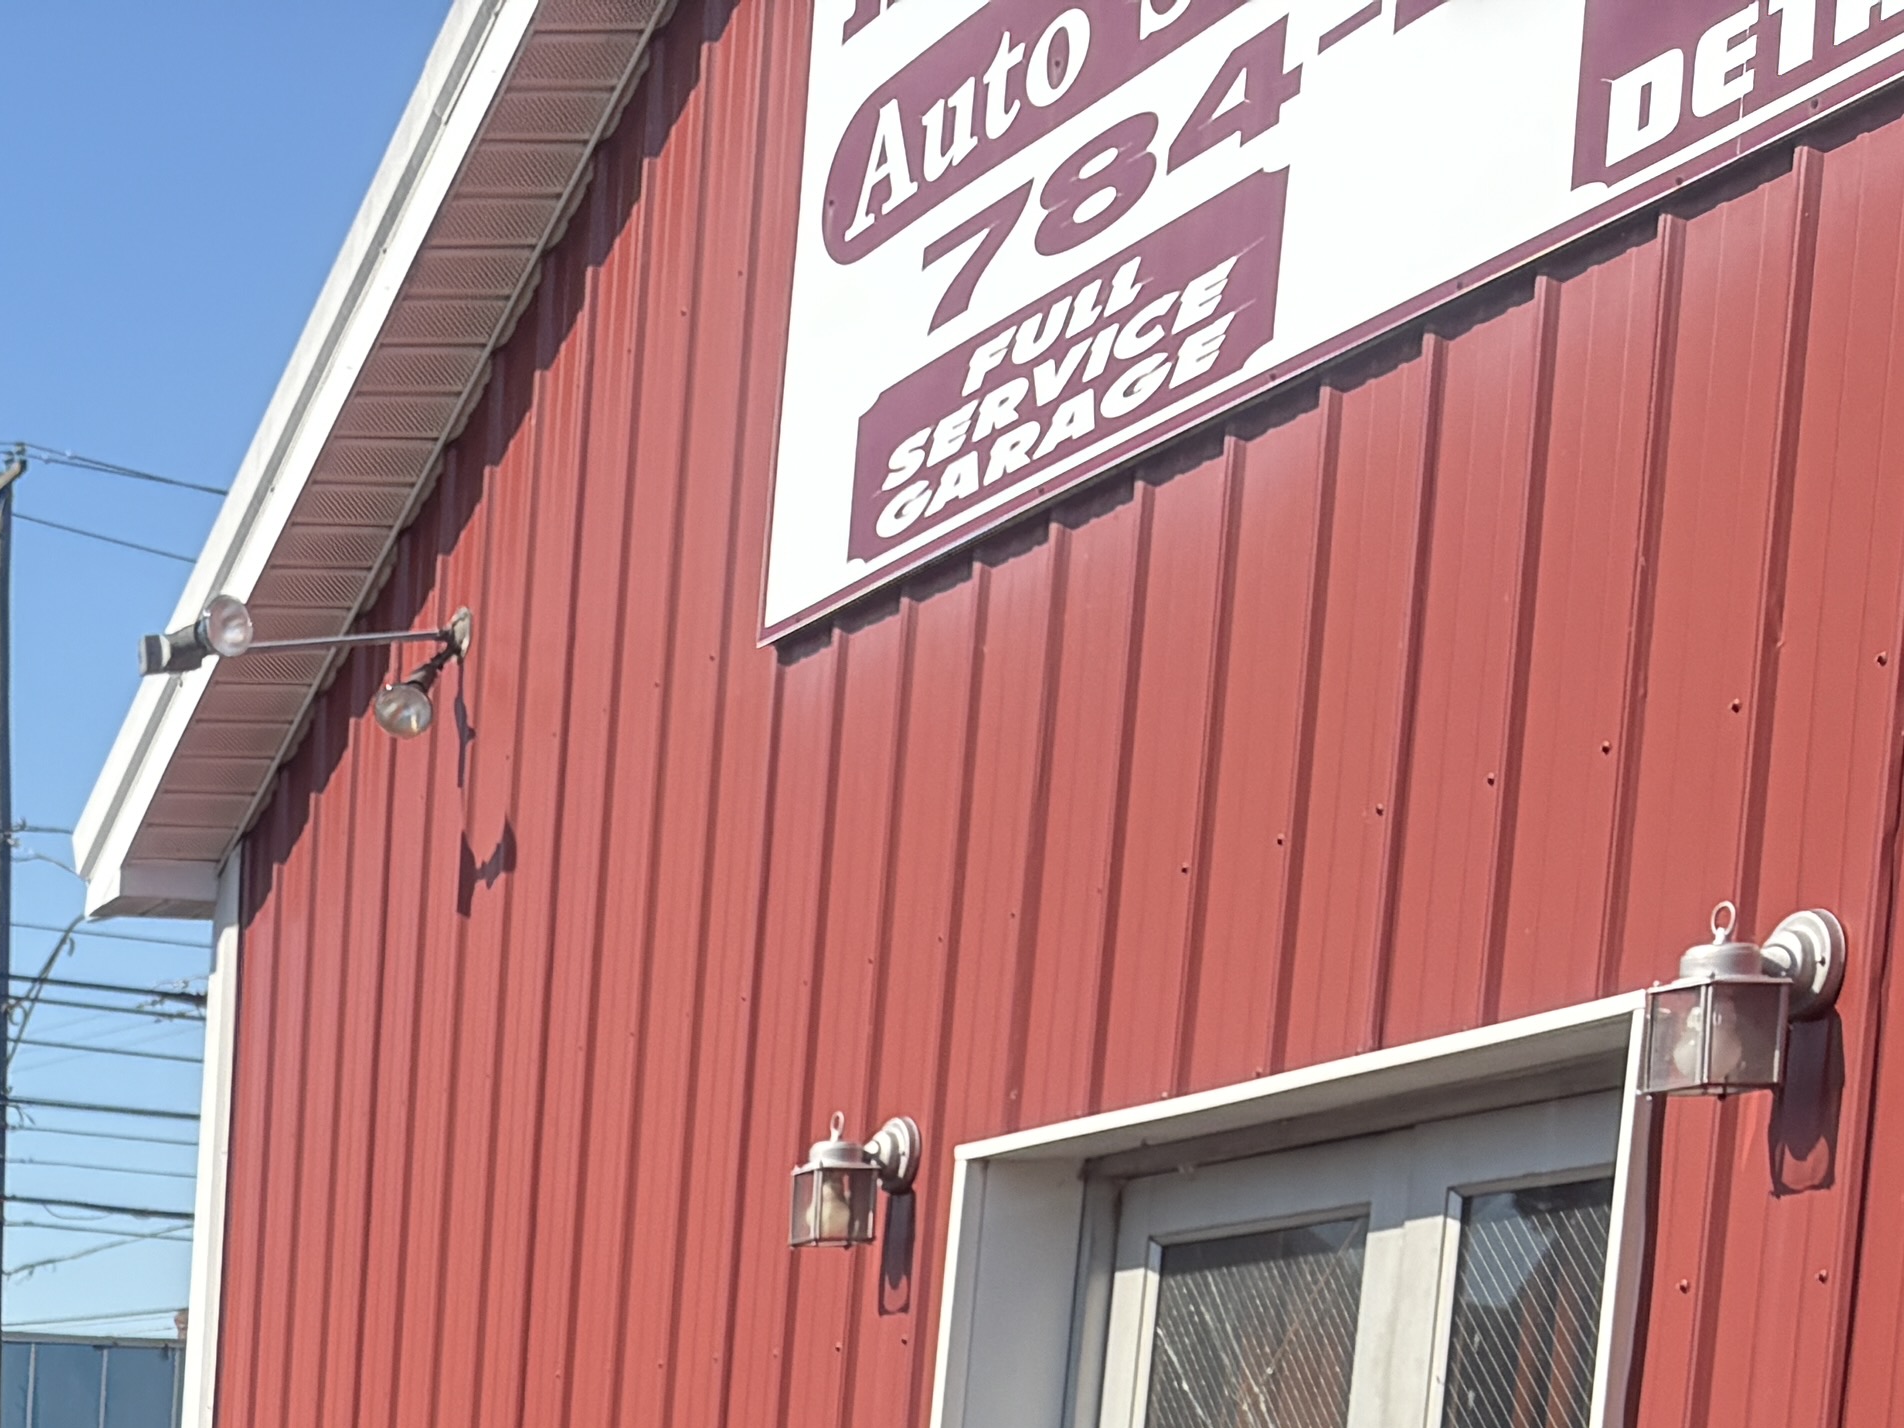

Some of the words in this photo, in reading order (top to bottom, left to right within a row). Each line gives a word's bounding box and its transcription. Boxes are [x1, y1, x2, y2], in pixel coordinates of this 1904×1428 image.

[844, 8, 1091, 243] Auto
[875, 311, 1236, 538] GARAGE
[882, 256, 1238, 491] SERVICE
[961, 256, 1143, 397] FULL
